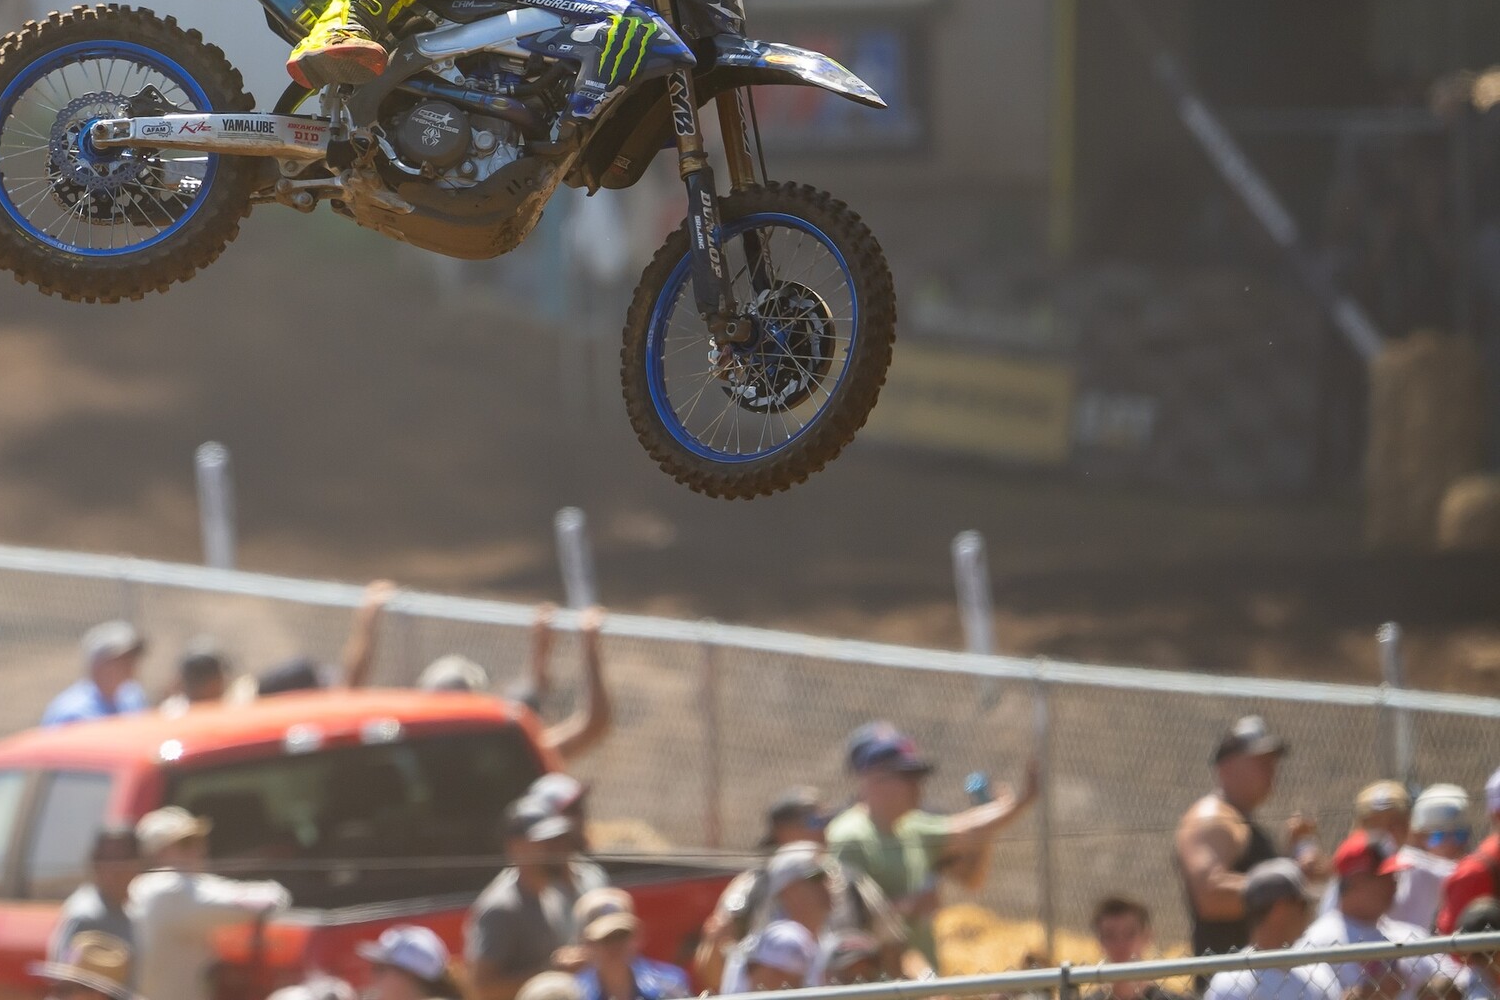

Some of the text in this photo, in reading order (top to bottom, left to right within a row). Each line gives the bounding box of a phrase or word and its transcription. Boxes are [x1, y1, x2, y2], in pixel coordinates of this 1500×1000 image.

[145, 126, 167, 134] AFAM
[222, 118, 276, 134] YAMALUBE
[287, 122, 327, 132] BRAKING
[700, 189, 722, 279] DUNLOP
